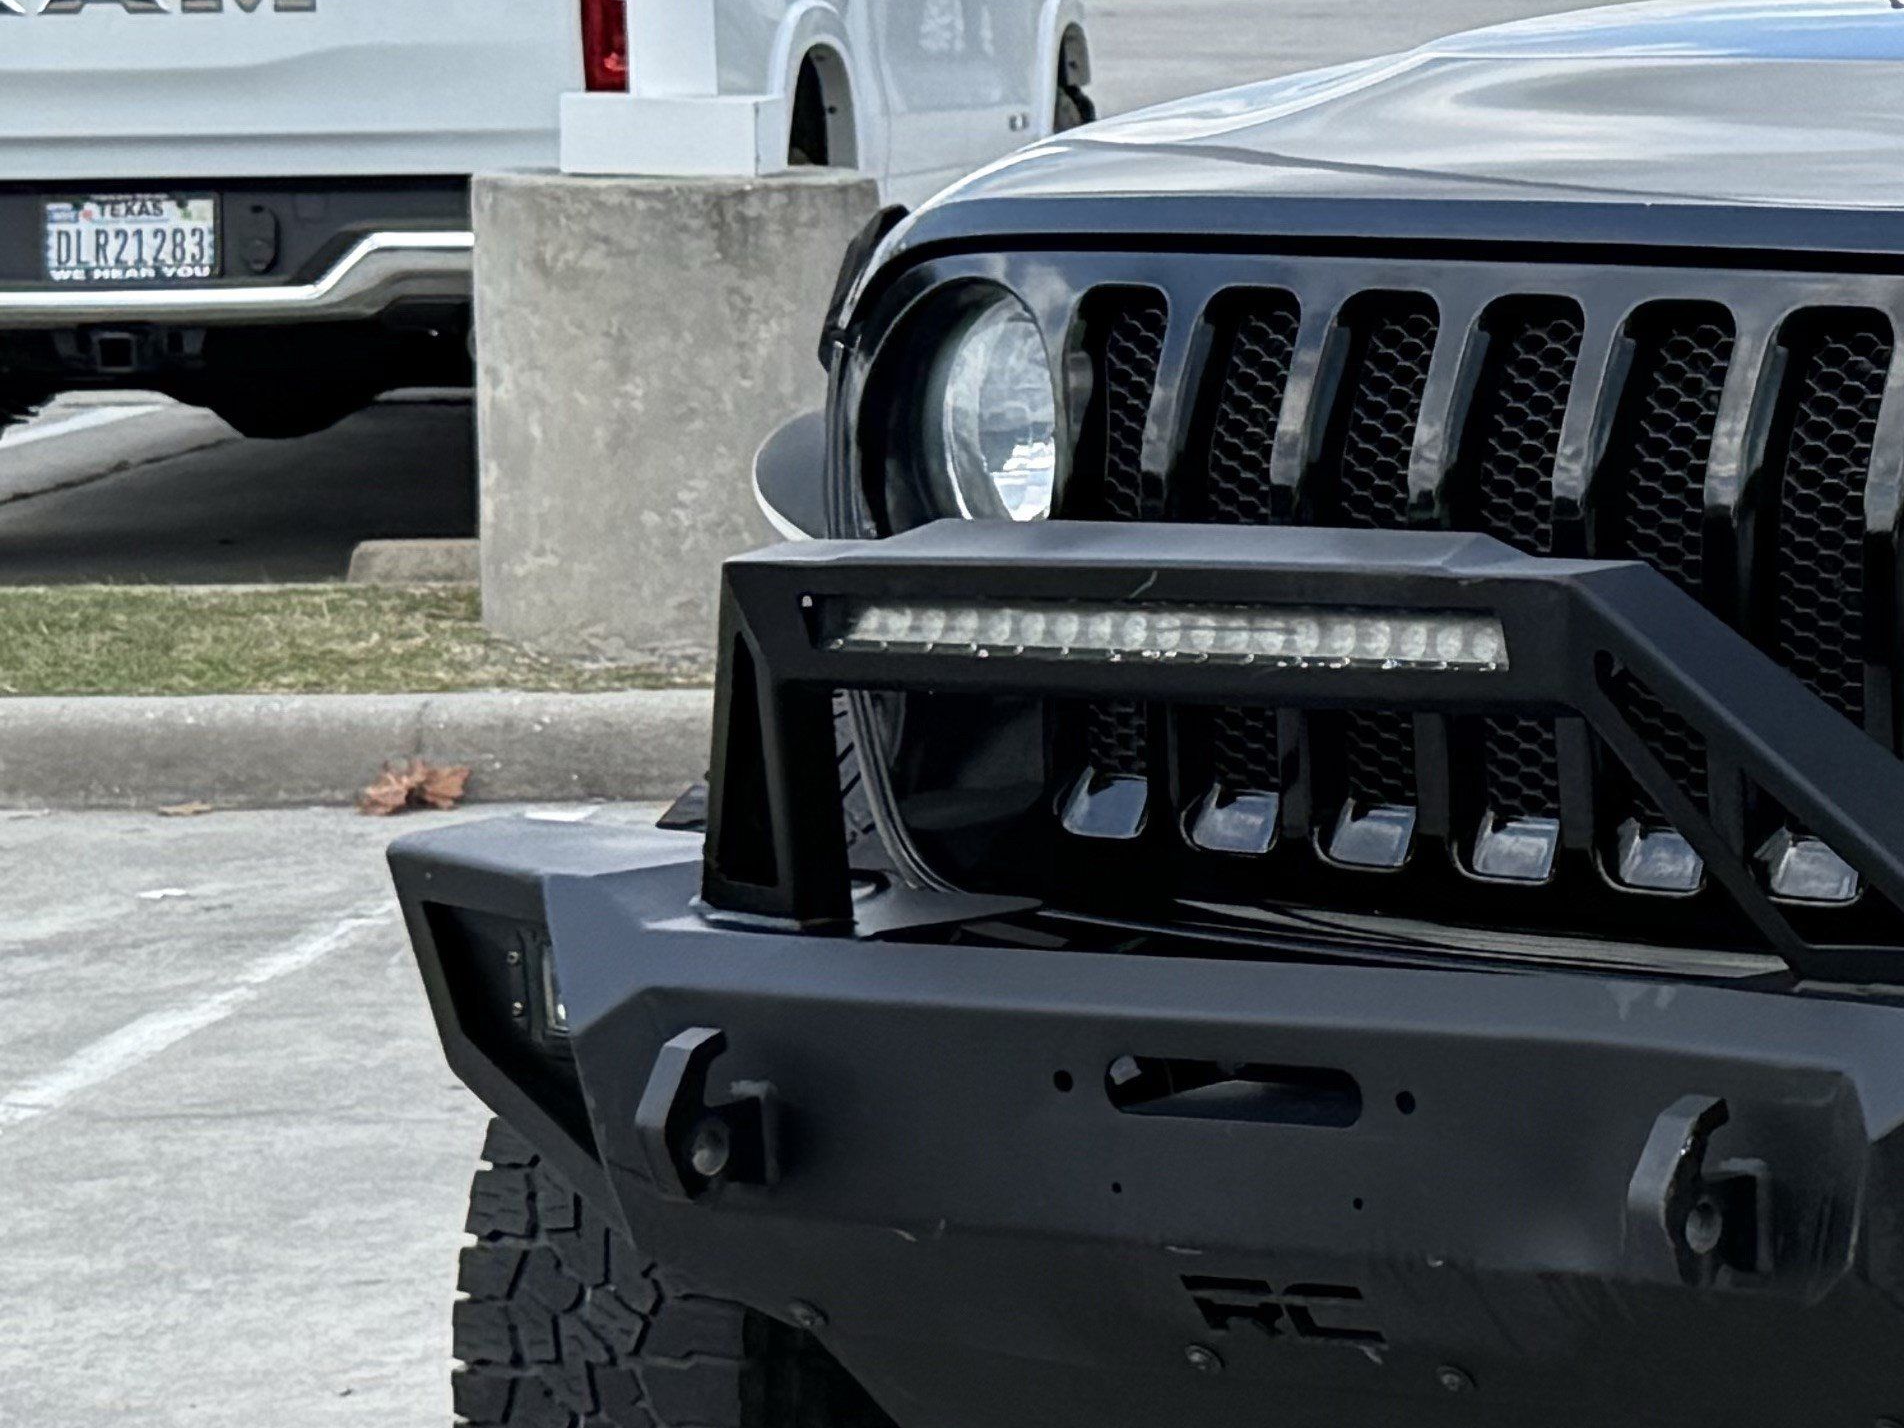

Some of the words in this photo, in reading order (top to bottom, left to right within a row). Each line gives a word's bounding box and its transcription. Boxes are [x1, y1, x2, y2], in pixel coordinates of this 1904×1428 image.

[100, 198, 165, 218] TEXAS
[56, 227, 204, 266] DLR21283
[1180, 1273, 1386, 1344] RC
